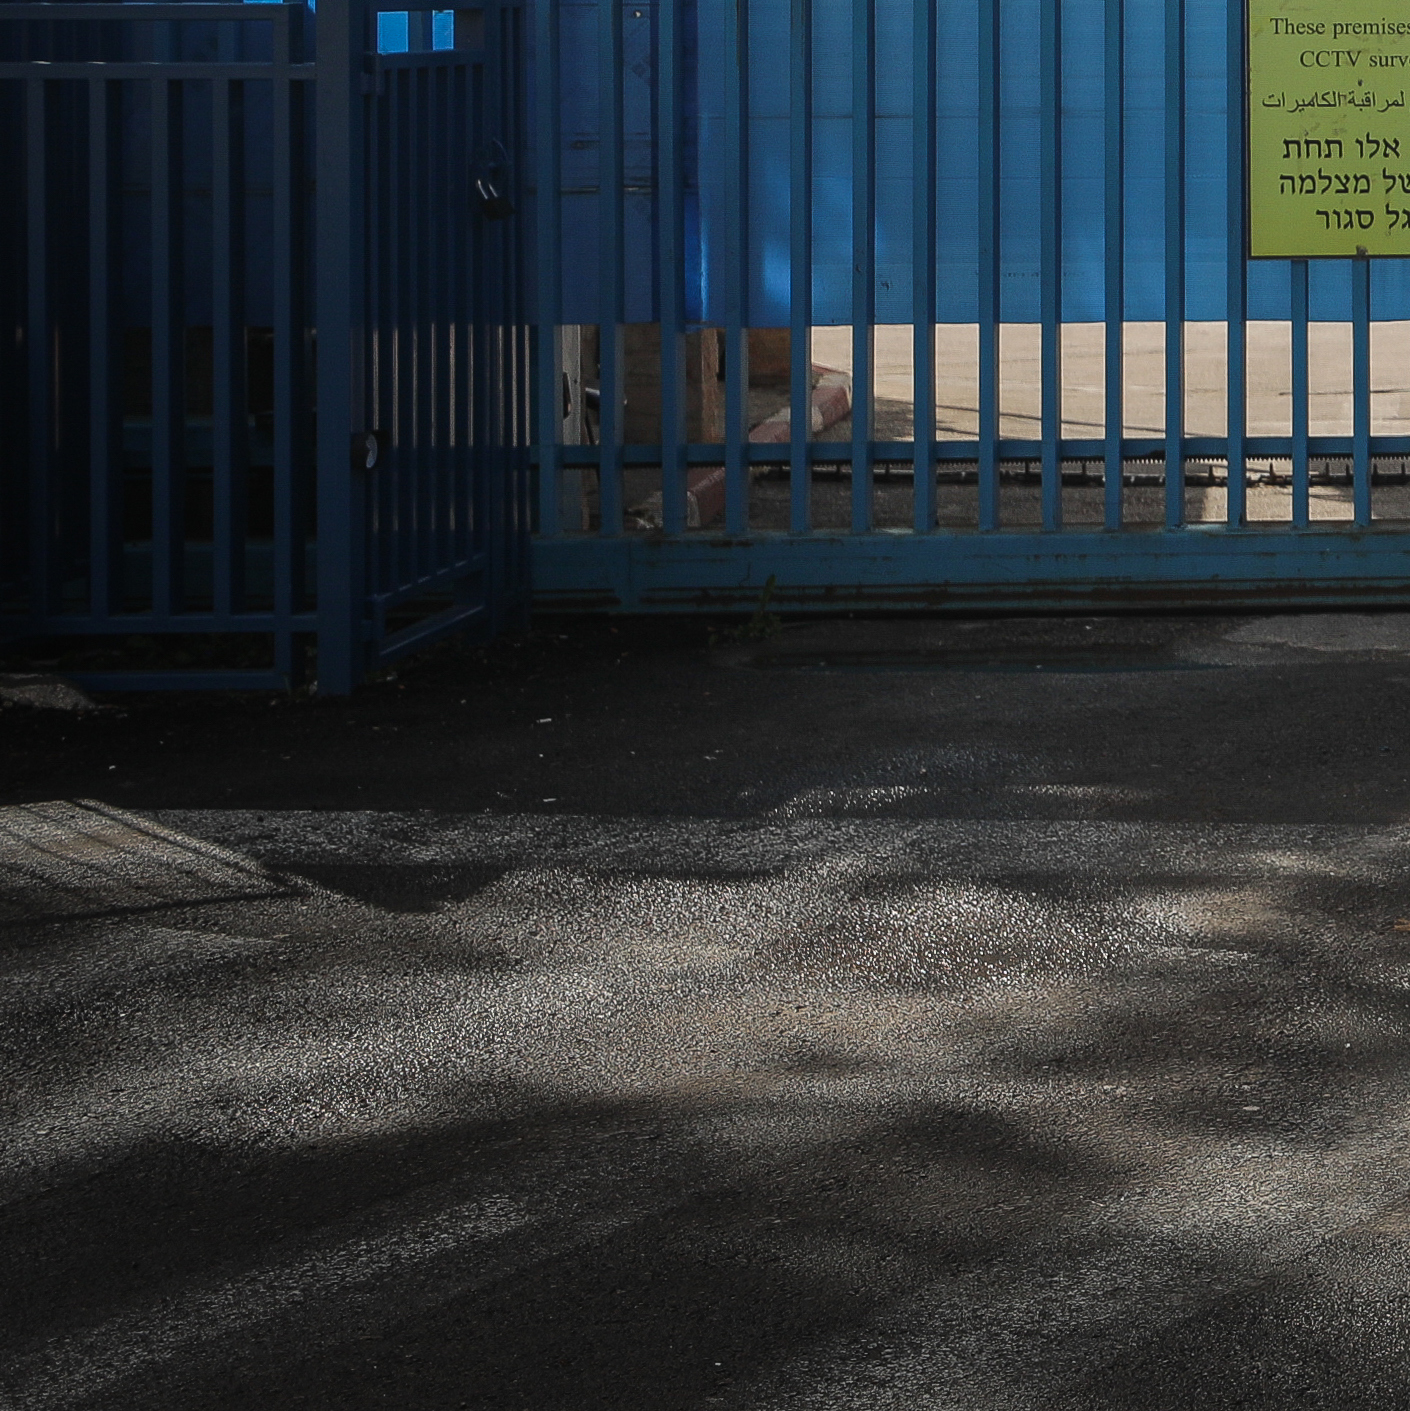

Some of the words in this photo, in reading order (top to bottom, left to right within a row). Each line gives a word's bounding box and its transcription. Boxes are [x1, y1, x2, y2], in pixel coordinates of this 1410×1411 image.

[1270, 18, 1325, 34] These
[1300, 51, 1361, 67] CCTV
[1262, 91, 1346, 113] الكاميرات
[1348, 91, 1404, 112] لمراقبة
[1283, 139, 1342, 158] תחת
[1355, 132, 1399, 158] אלו
[1280, 168, 1370, 194] מצלמה
[1316, 209, 1374, 229] סגור
